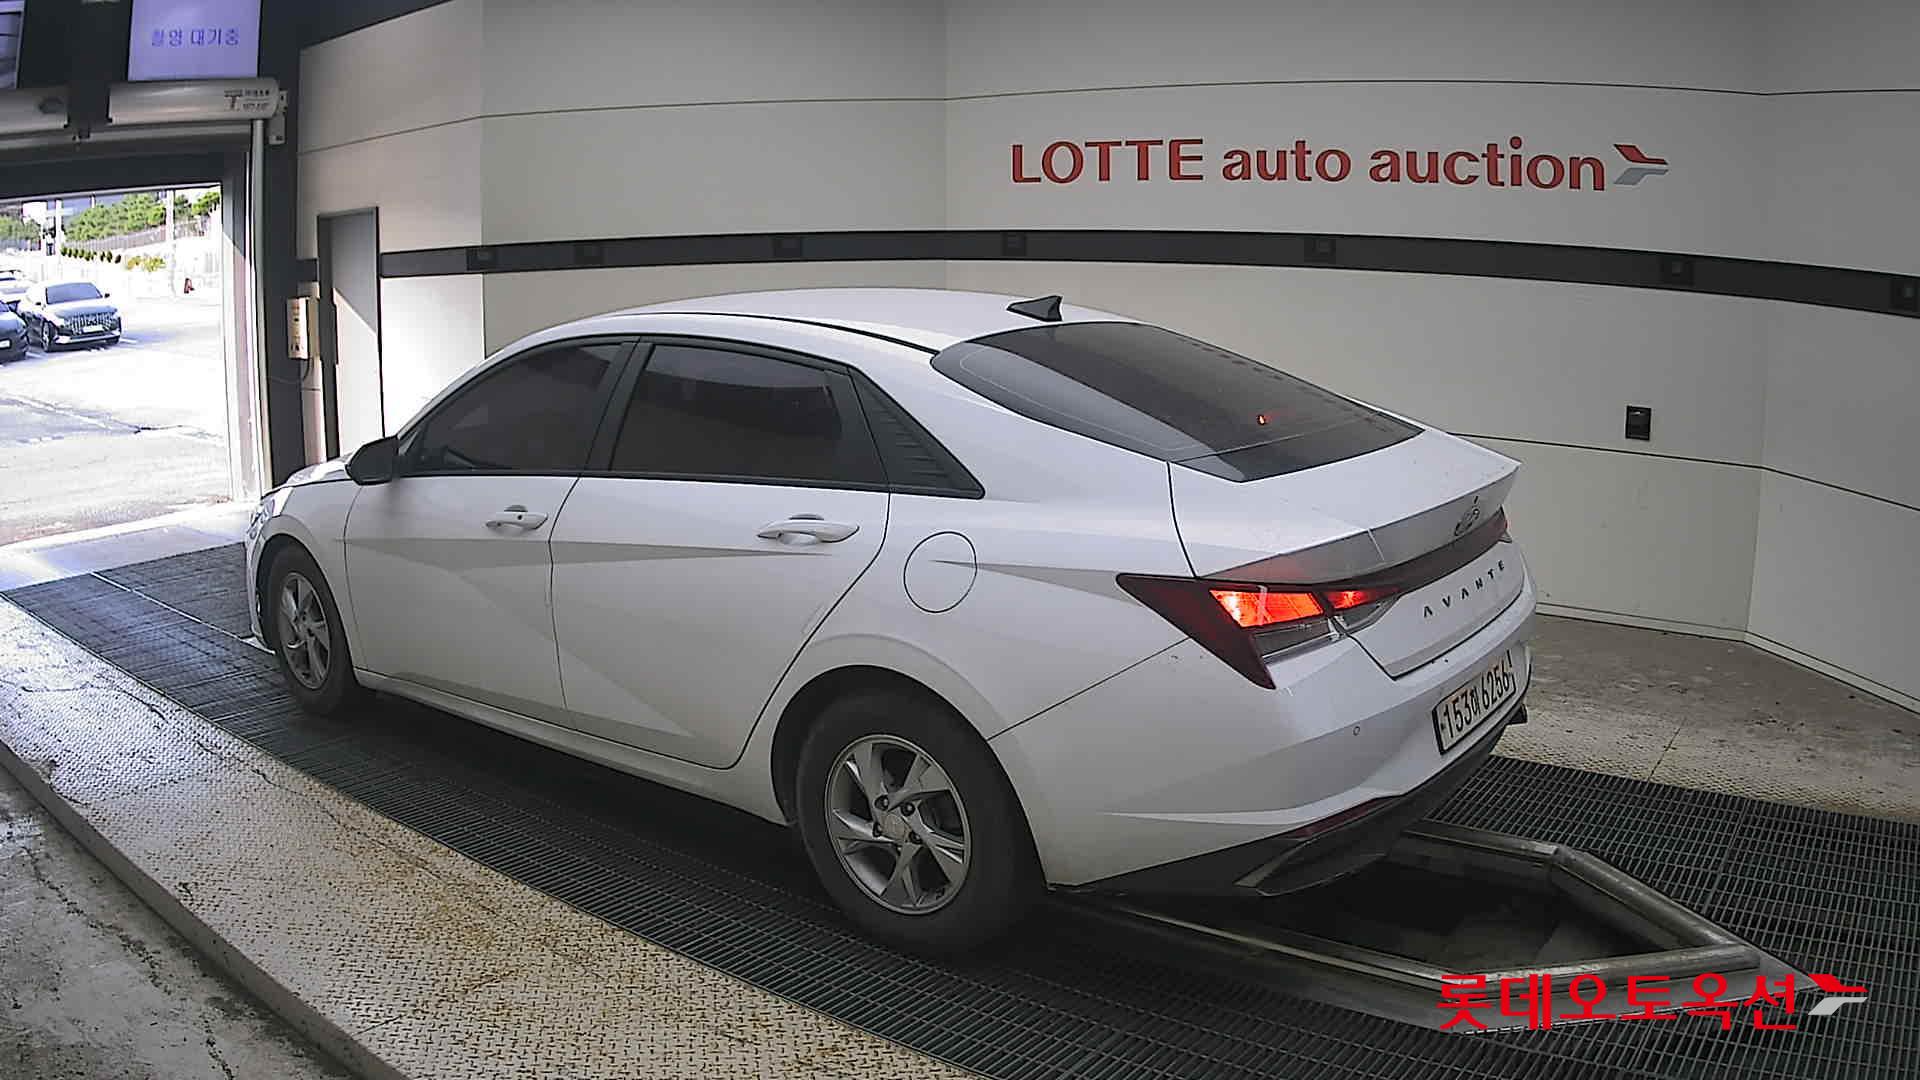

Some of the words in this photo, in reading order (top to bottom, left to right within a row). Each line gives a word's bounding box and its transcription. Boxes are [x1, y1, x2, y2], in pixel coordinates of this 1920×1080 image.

[1011, 139, 1203, 184] LOTTE
[1221, 140, 1352, 182] auto
[1368, 137, 1606, 192] auction
[1422, 559, 1505, 619] AVANTE
[1481, 659, 1510, 711] 6256
